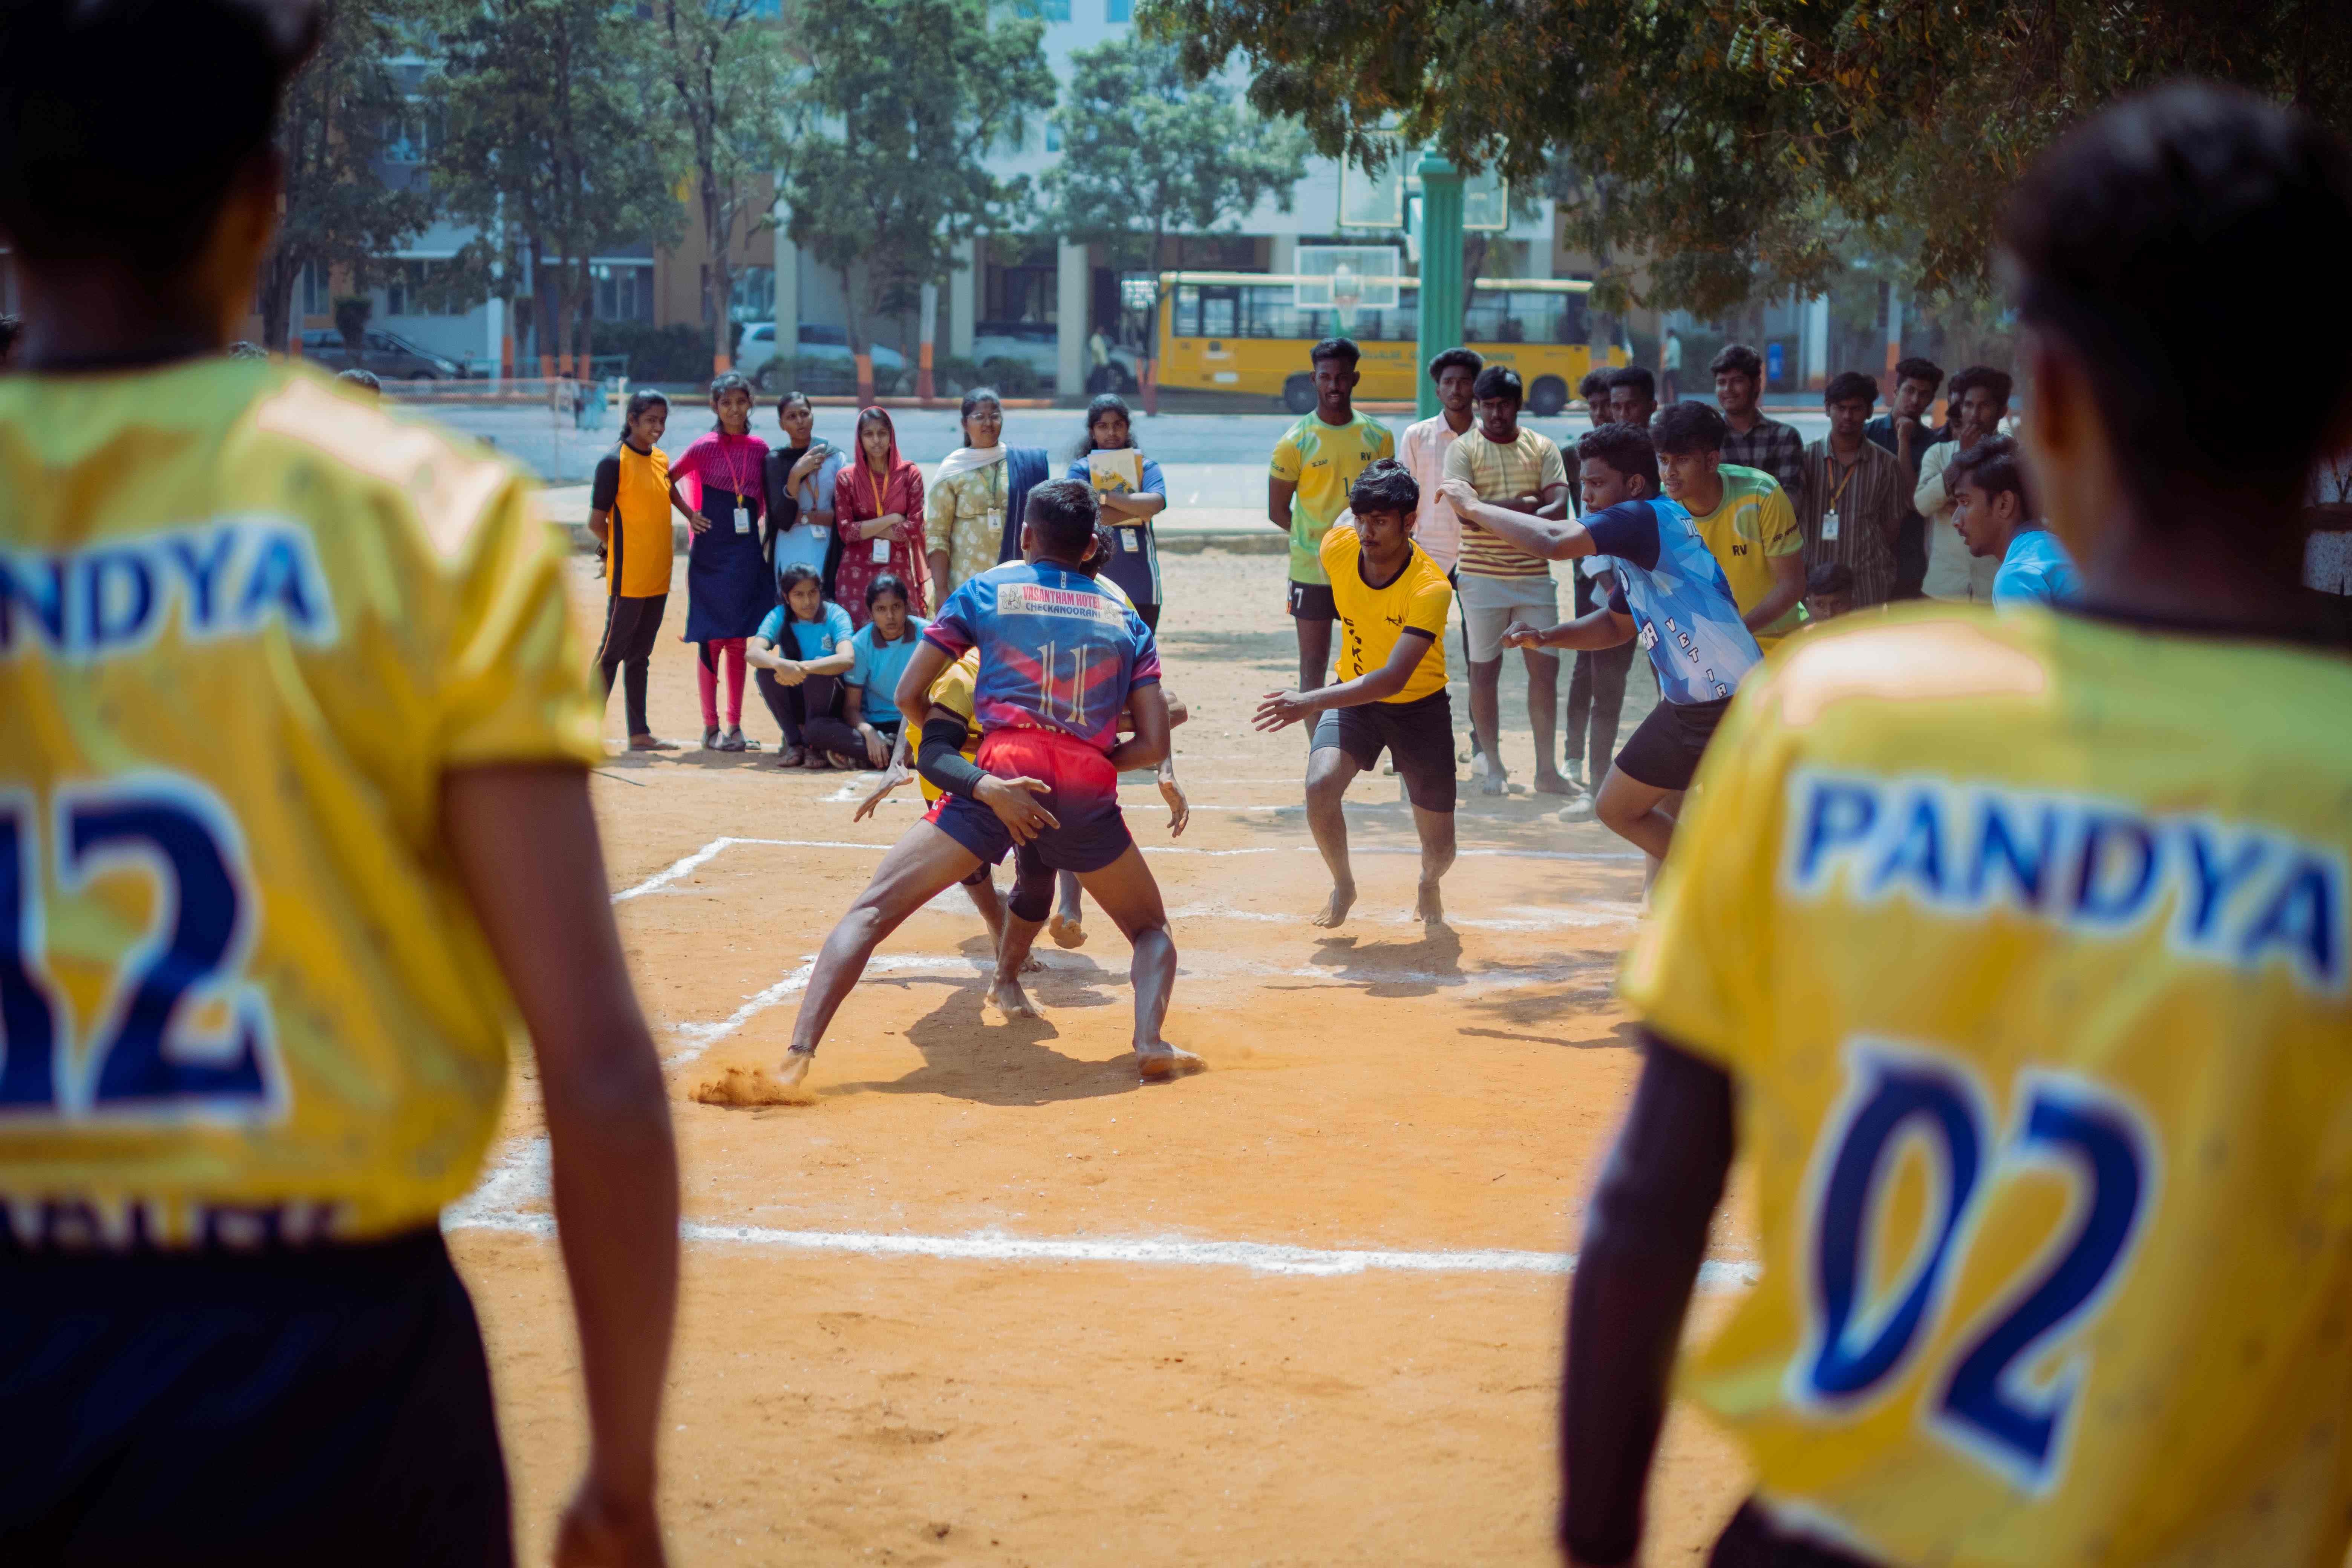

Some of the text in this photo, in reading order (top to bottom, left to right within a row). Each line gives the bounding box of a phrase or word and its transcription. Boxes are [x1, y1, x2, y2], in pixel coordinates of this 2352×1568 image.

[1361, 452, 1371, 461] RV
[1732, 543, 1747, 556] RV
[1023, 586, 1102, 610] VASANTHAM HOTEL
[1025, 602, 1101, 619] CHECKANOORANI
[1037, 639, 1088, 727] 11
[1787, 769, 2346, 988] PANDYA
[1792, 1042, 2152, 1485] 02
